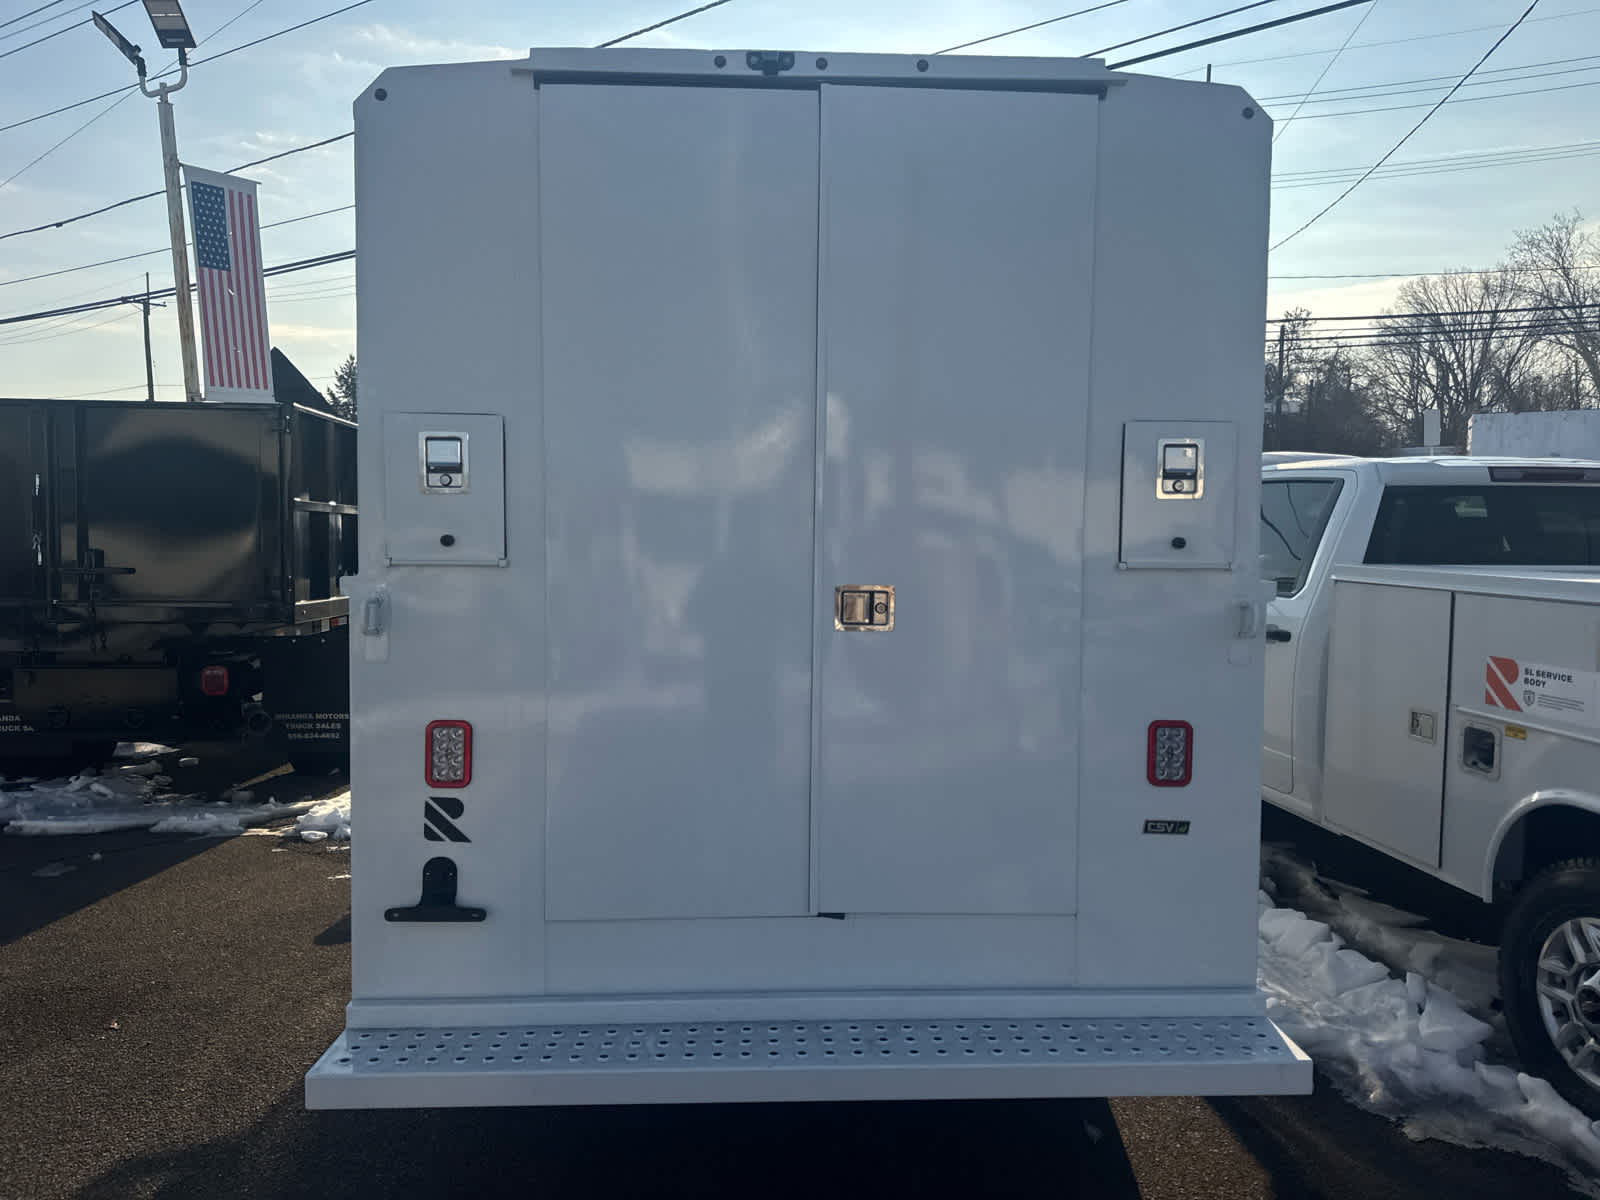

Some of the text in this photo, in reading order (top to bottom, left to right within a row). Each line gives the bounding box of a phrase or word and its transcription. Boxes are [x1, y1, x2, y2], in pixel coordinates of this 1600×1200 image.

[1524, 667, 1574, 683] SL SERVICE
[1523, 677, 1547, 688] BODY
[316, 713, 349, 721] MOTORS
[316, 722, 341, 730] SALES
